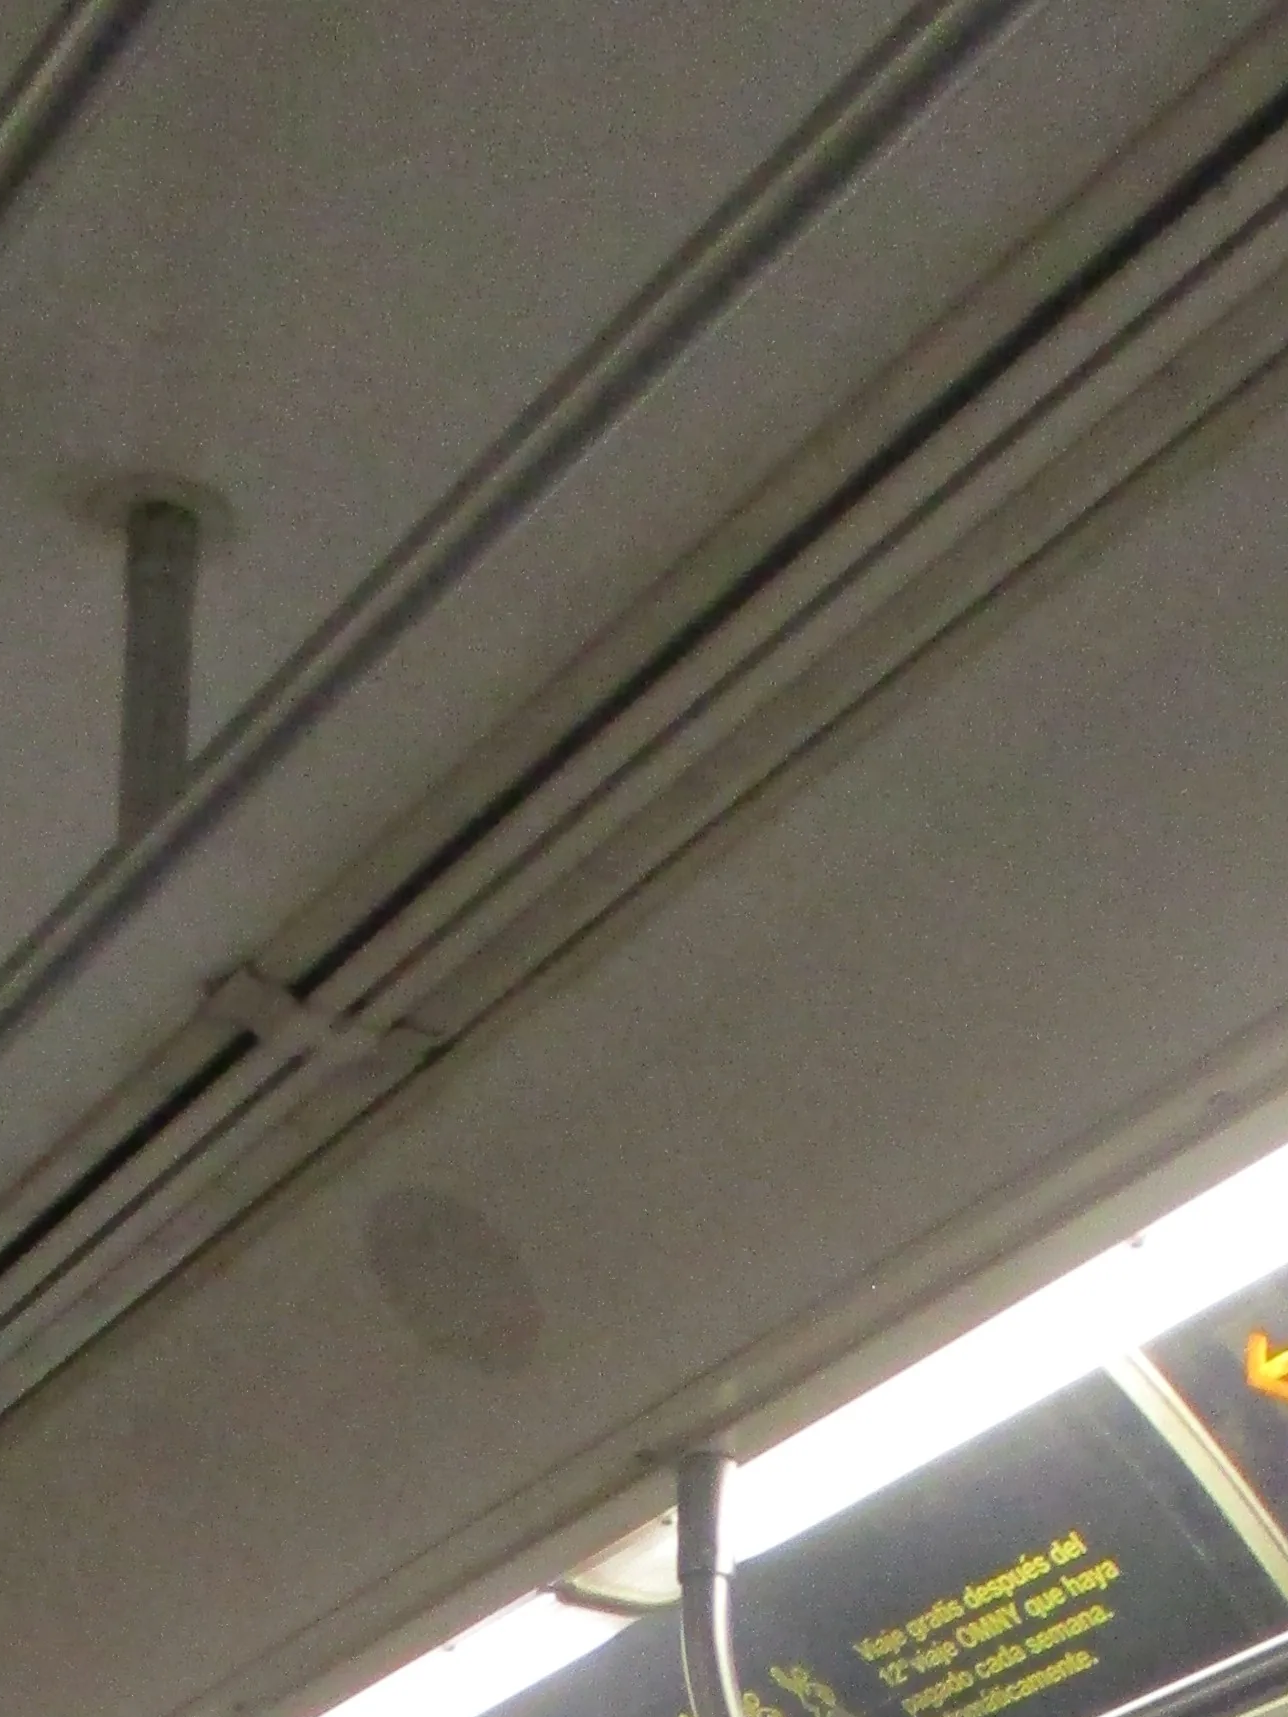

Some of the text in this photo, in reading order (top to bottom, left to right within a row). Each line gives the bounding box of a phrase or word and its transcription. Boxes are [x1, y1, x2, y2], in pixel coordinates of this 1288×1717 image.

[907, 1599, 964, 1641] gratis
[963, 1554, 1052, 1608] después
[1049, 1531, 1088, 1566] del
[954, 1603, 1021, 1648] OMNY
[1023, 1586, 1068, 1618] que
[1061, 1559, 1121, 1597] haya
[974, 1644, 1028, 1679] cada
